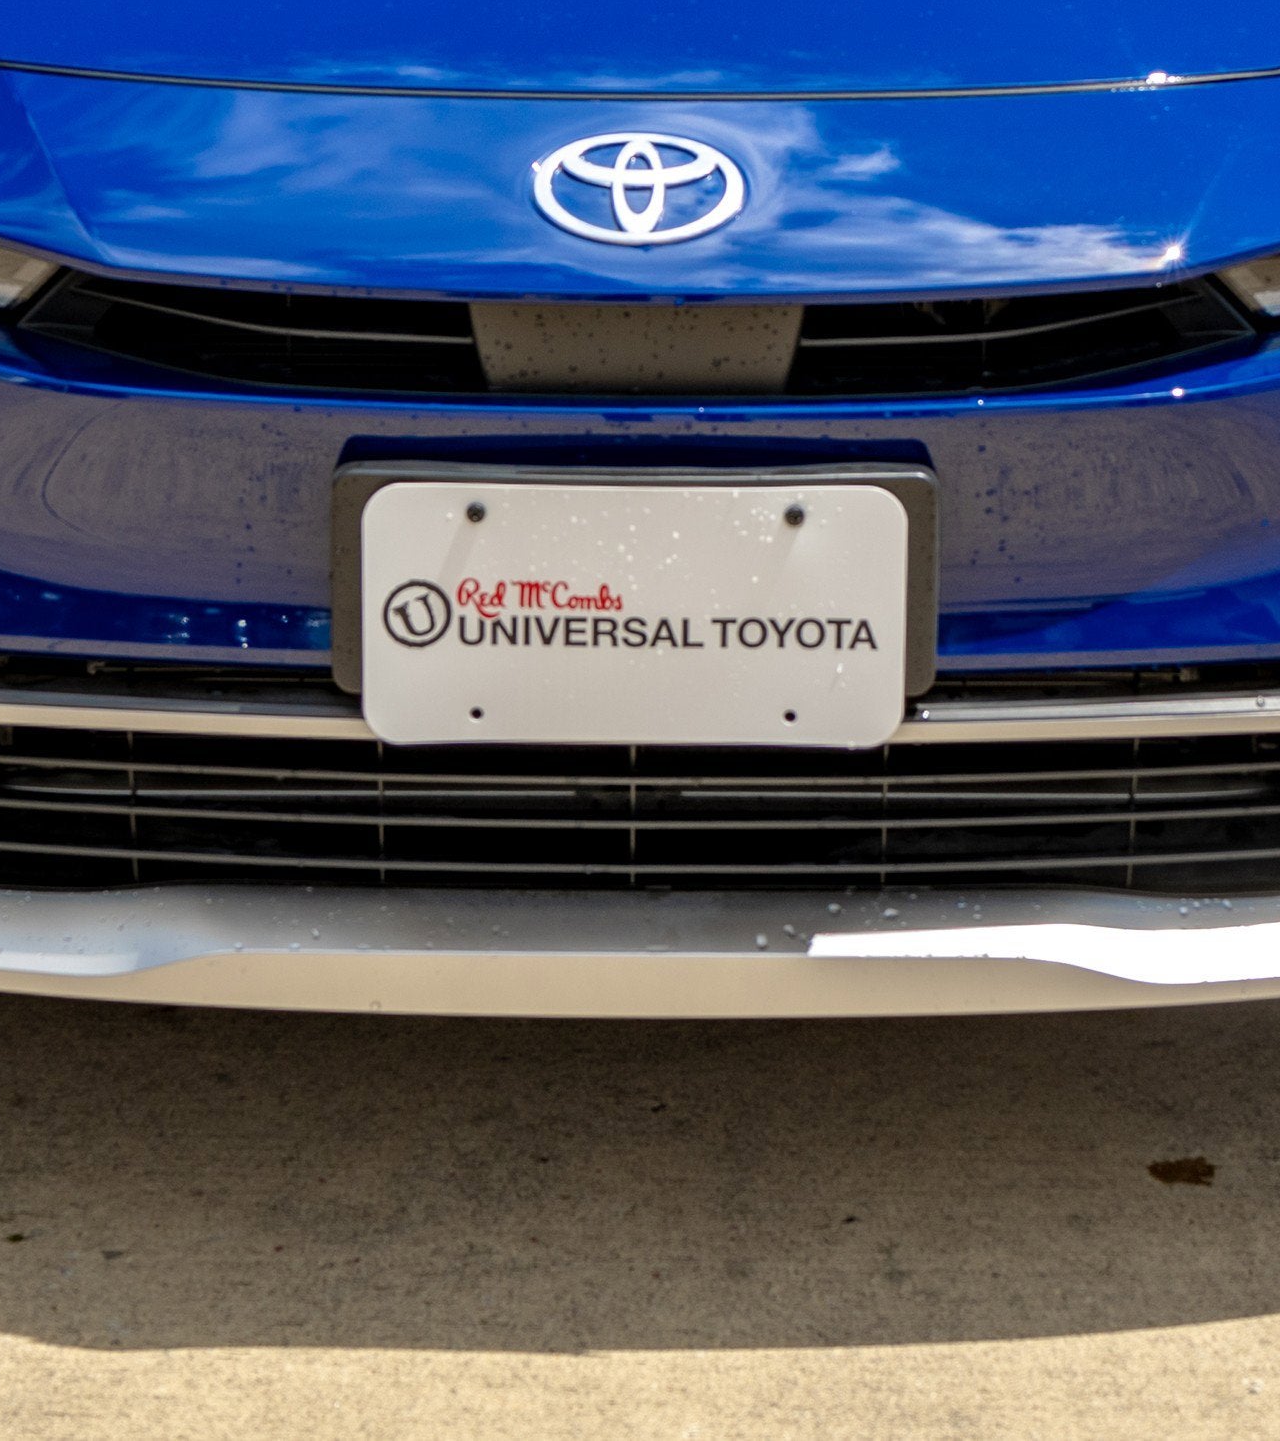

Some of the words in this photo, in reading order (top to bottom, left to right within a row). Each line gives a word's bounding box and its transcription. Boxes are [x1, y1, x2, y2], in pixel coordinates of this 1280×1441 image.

[457, 578, 506, 618] Red
[459, 617, 705, 649] UNIVERSAL
[712, 618, 879, 651] TOYOTA
